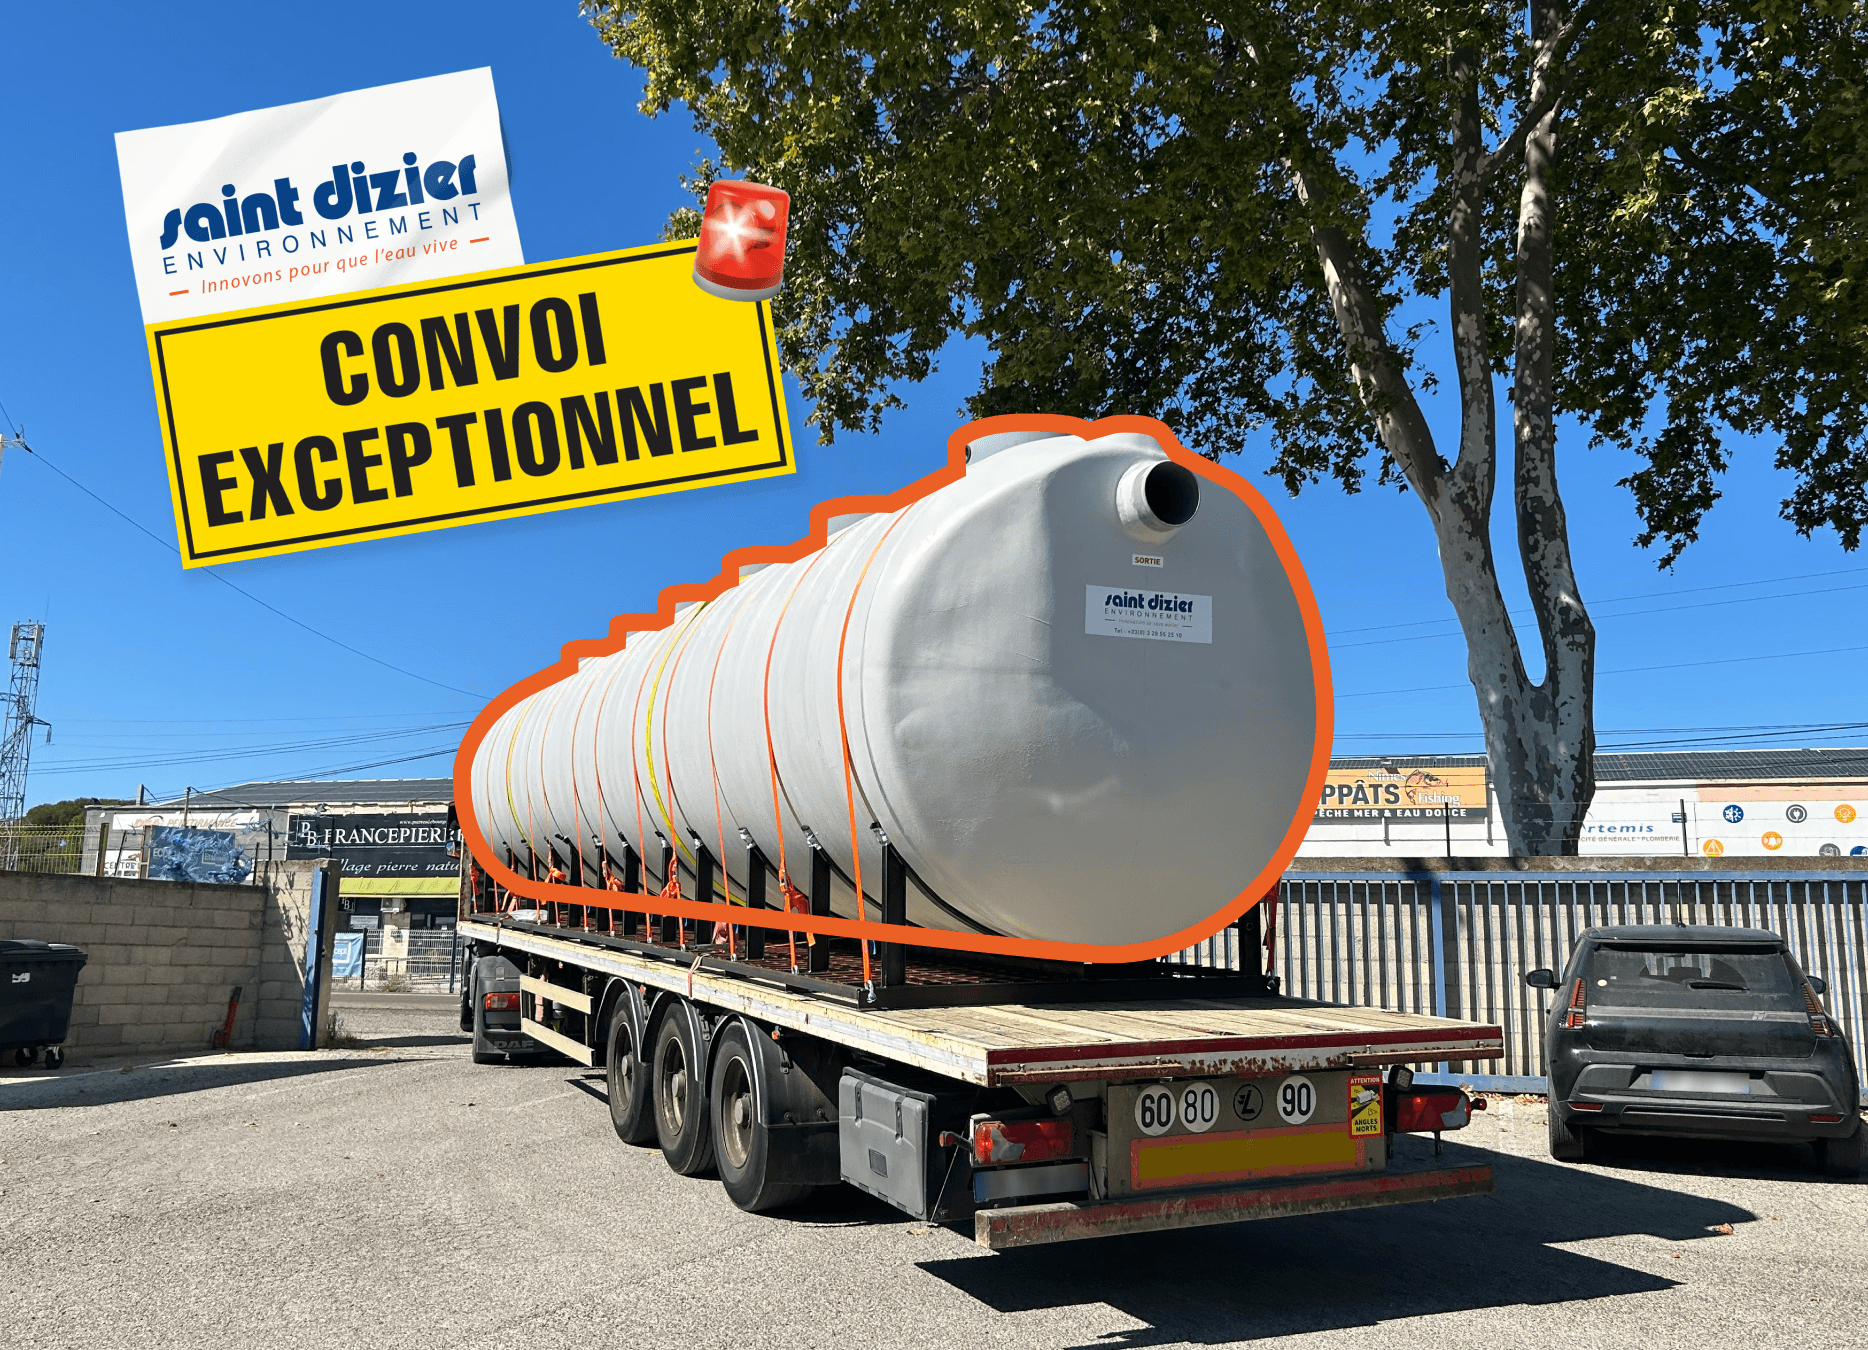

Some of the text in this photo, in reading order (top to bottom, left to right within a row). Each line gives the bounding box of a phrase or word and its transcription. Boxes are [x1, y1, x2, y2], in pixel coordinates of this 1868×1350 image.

[1134, 556, 1161, 565] SORTIE
[1104, 591, 1193, 613] saint dizier
[1104, 607, 1193, 621] ENVIRONNEMENT
[1417, 791, 1461, 808] Fishing
[1354, 809, 1379, 817] MER
[1383, 809, 1392, 817] &
[1397, 809, 1421, 817] EAU
[376, 861, 418, 875] pierre
[494, 1040, 534, 1049] DAF
[1184, 1088, 1214, 1124] 80
[1282, 1082, 1311, 1117] 90
[1141, 1092, 1171, 1128] 60
[1354, 1118, 1378, 1126] ANGLES
[1355, 1125, 1378, 1133] MORTS
